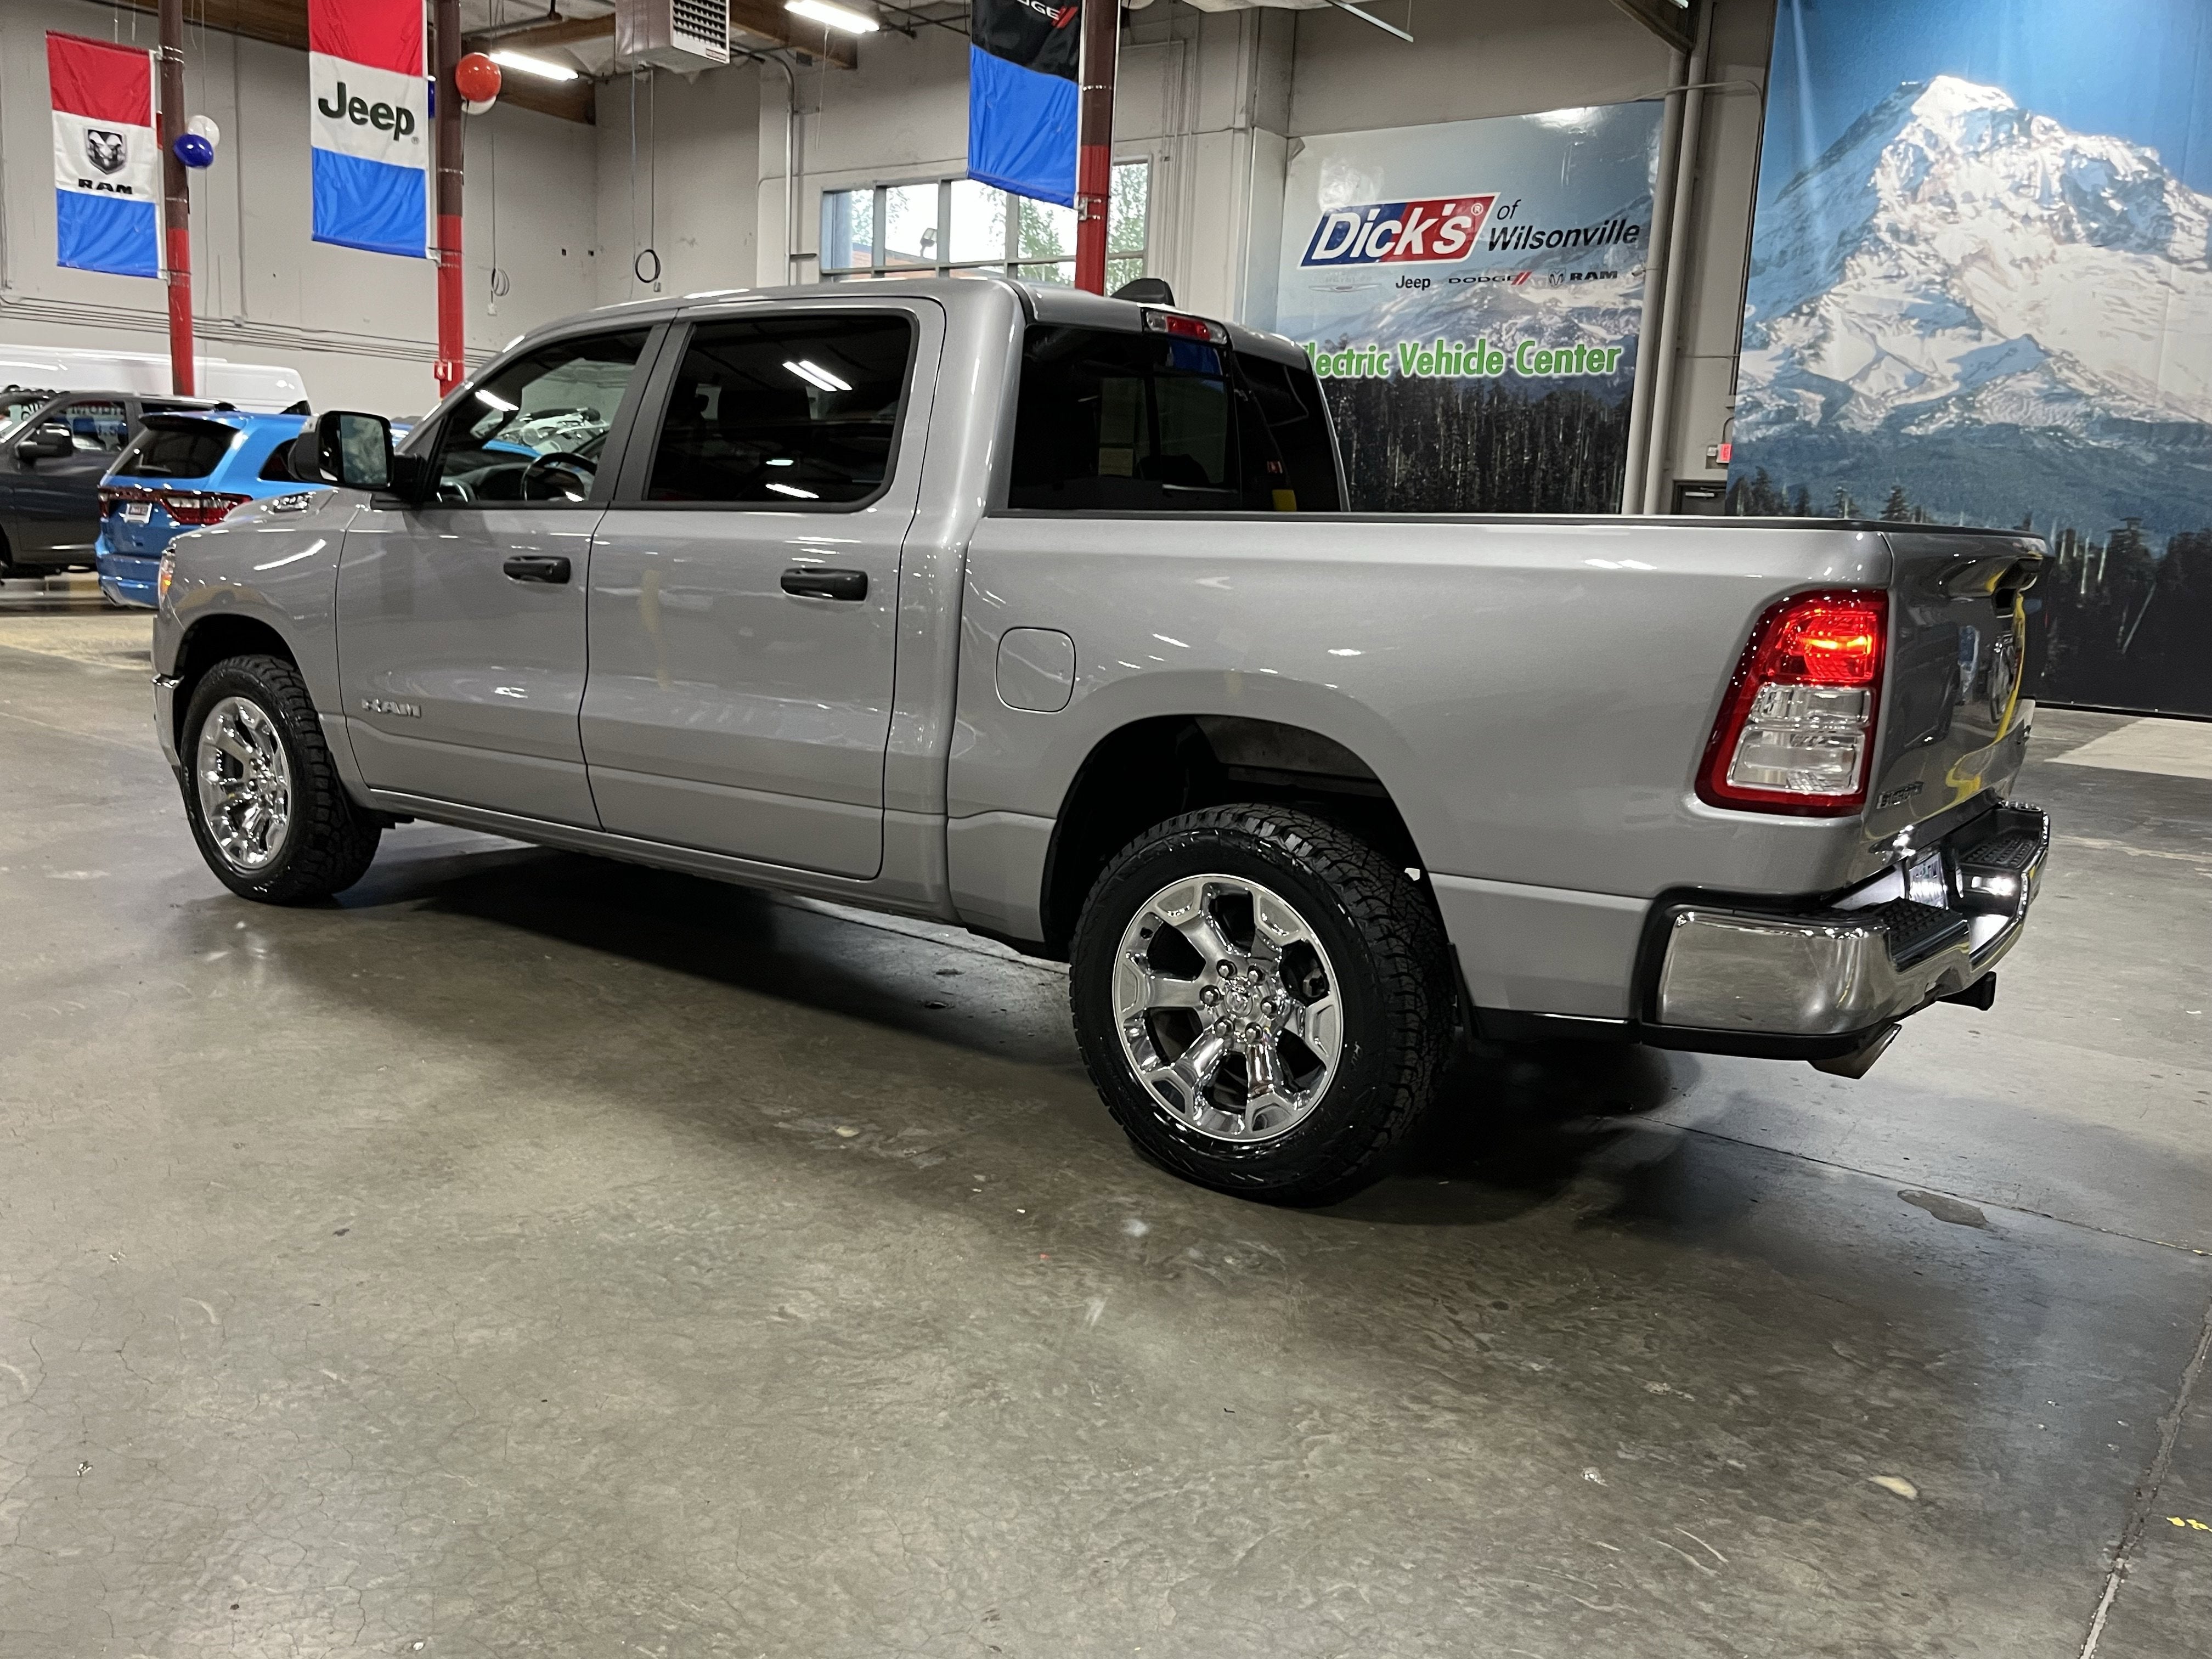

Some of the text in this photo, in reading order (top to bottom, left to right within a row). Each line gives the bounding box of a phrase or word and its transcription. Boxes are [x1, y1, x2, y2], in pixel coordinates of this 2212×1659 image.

[318, 81, 415, 142] Jeep
[78, 178, 132, 194] RAM
[1497, 199, 1521, 219] of
[1488, 219, 1640, 251] Wilsonville
[1395, 275, 1431, 291] Jeep
[1570, 271, 1617, 280] RAM
[1304, 339, 1621, 376] lectric Vehicle Center
